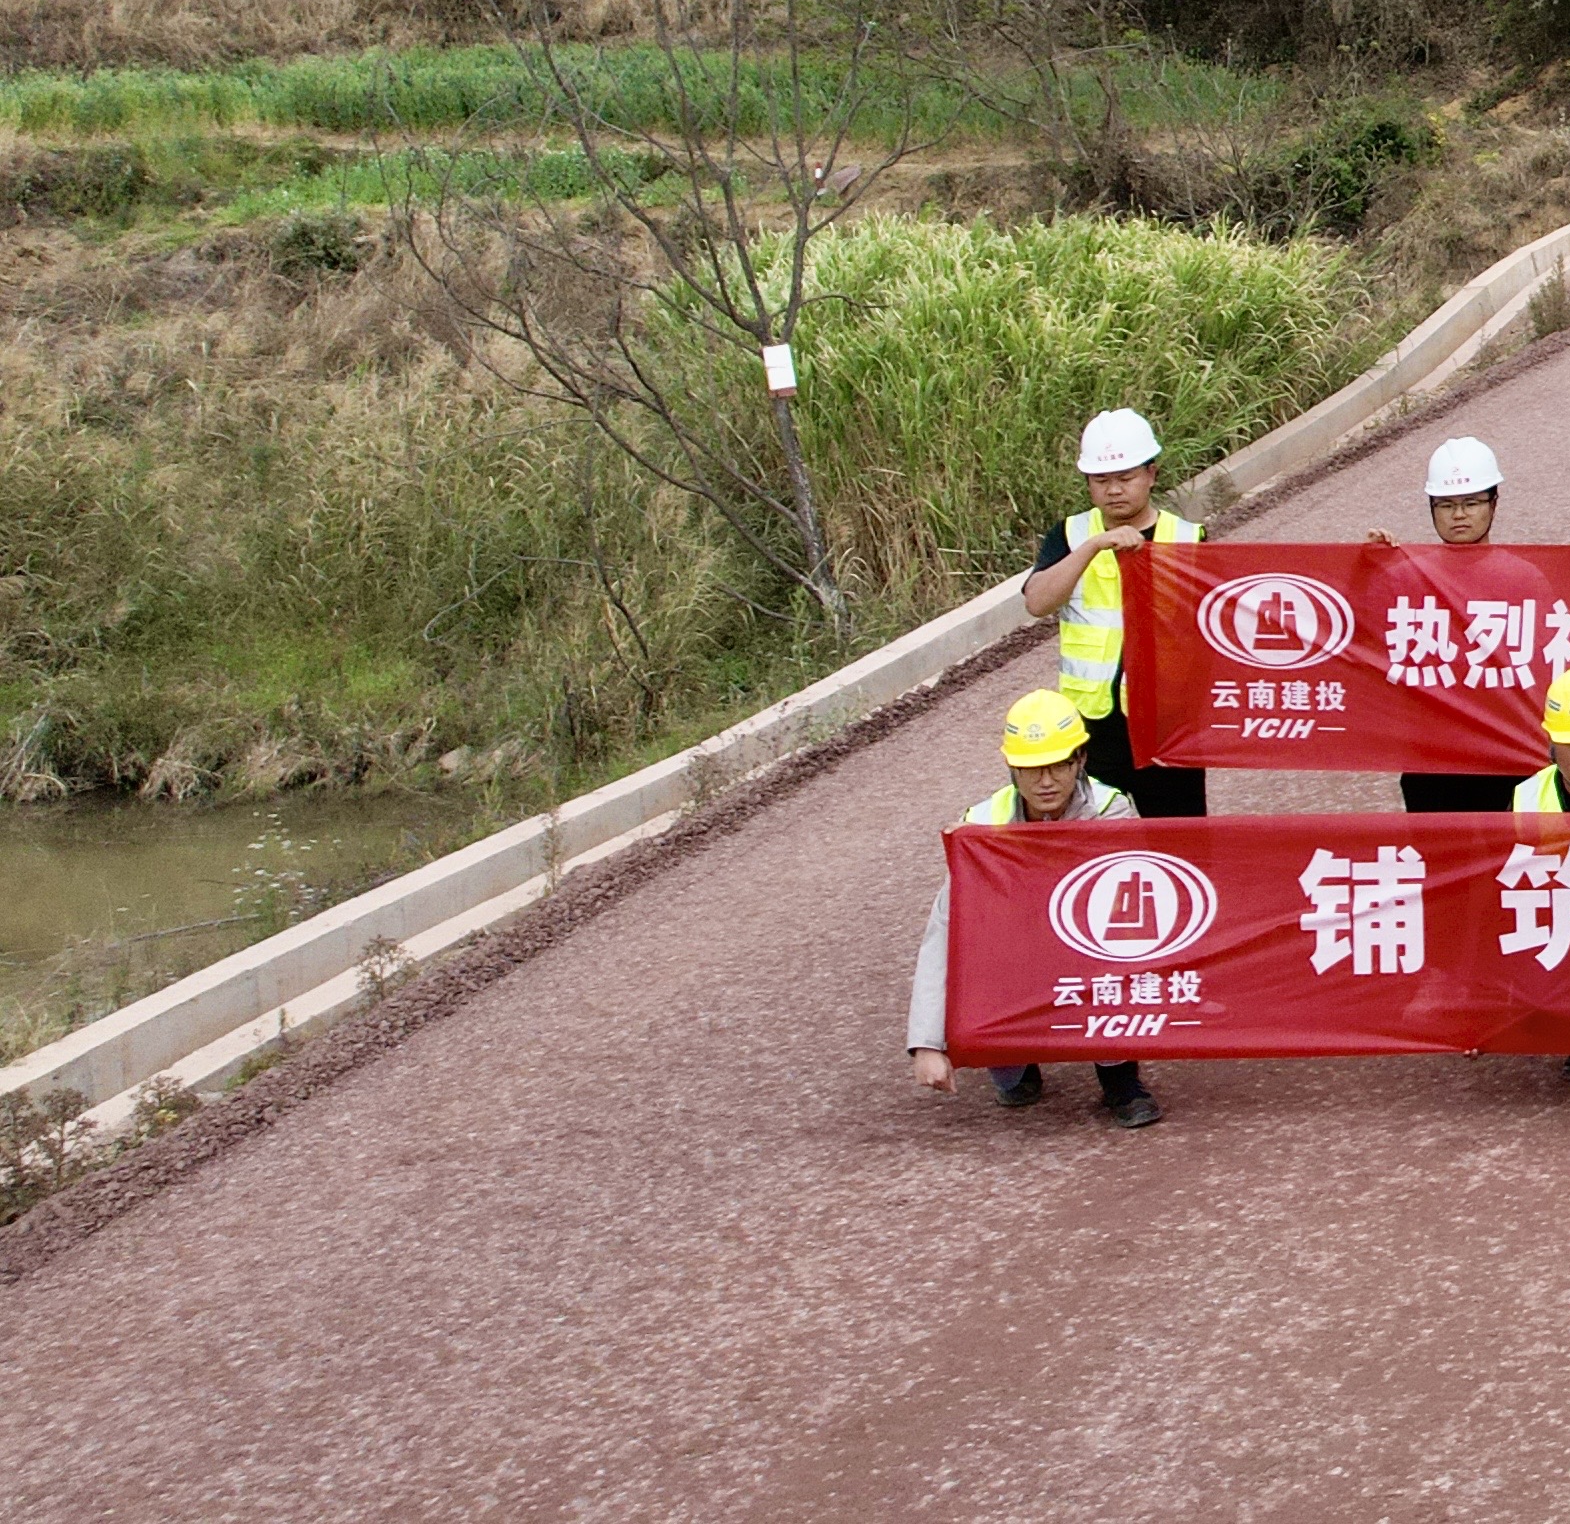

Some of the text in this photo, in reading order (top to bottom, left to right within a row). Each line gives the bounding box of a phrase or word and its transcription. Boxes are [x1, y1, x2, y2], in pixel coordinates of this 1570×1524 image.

[1211, 680, 1347, 712] 云南建投
[1240, 718, 1316, 739] YCIH
[1053, 971, 1202, 1007] 云南建投
[1084, 1014, 1168, 1038] YCIH
